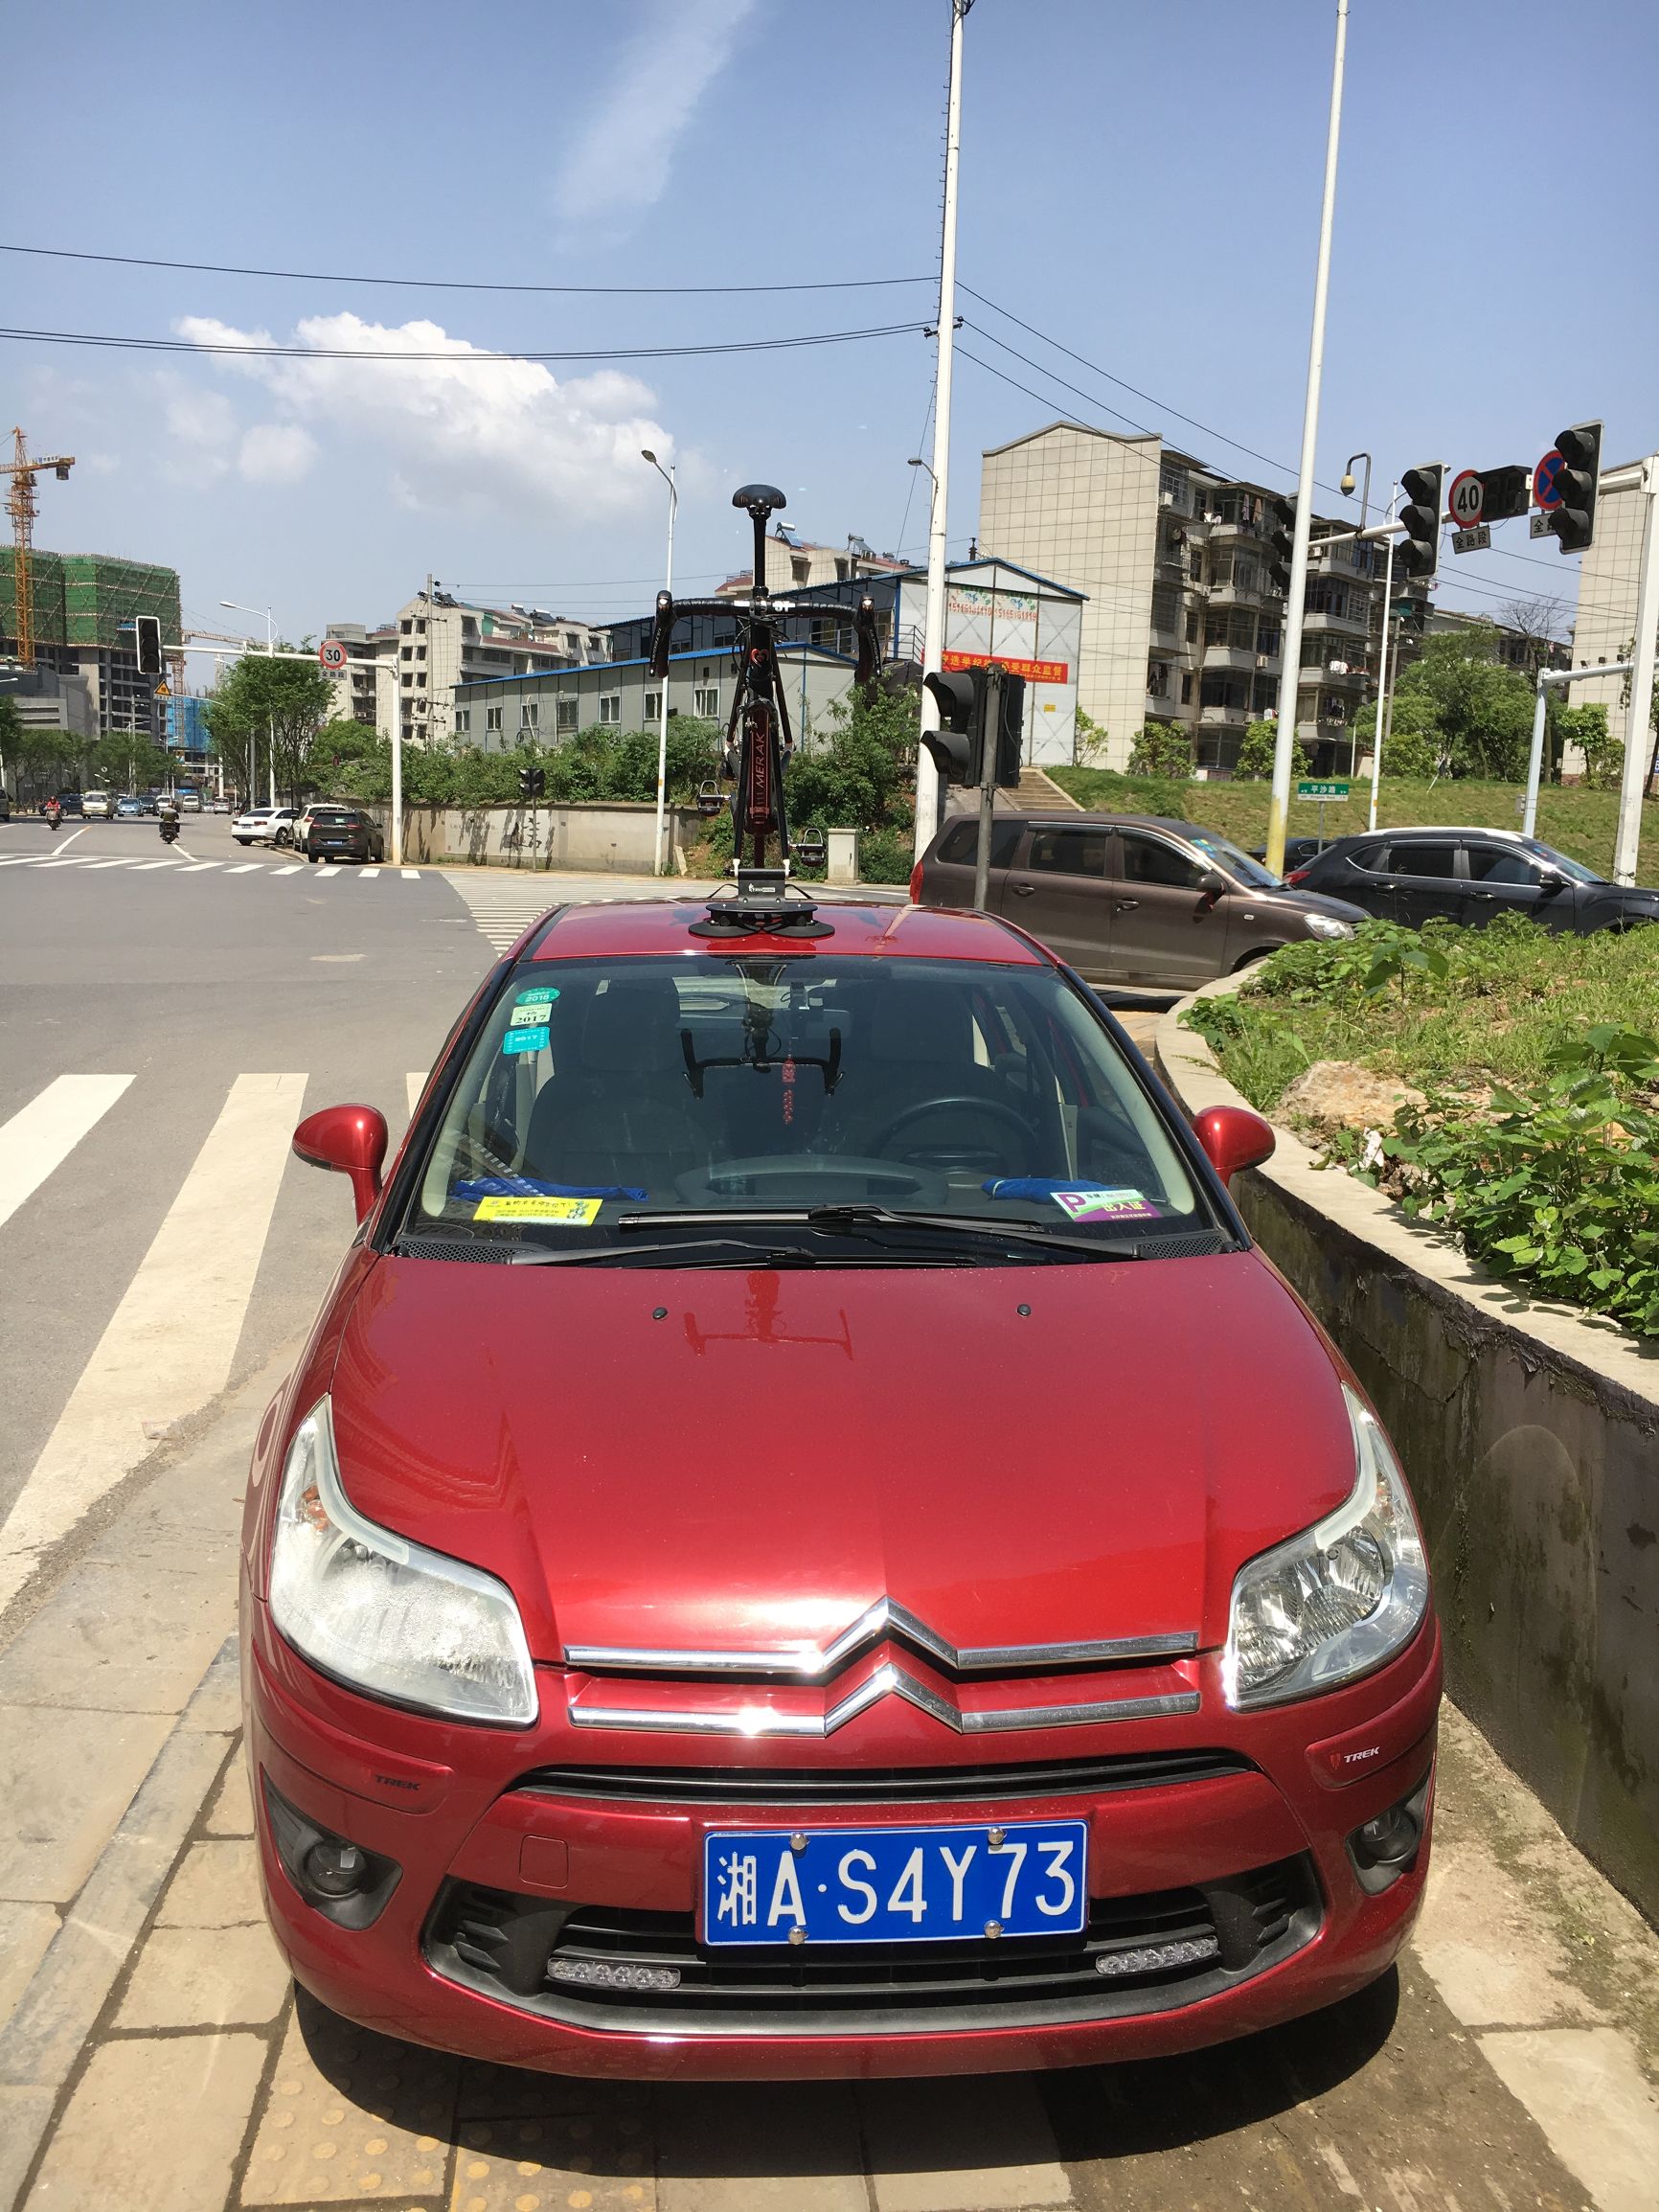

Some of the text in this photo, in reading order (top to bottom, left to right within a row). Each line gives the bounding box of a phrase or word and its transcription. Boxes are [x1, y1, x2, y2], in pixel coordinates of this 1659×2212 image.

[1457, 485, 1480, 513] 40
[1455, 532, 1488, 550] 全路段
[326, 650, 341, 661] 30
[321, 670, 345, 678] 全路段
[755, 732, 765, 788] MERAK
[515, 1015, 546, 1024] 2017
[1057, 1194, 1087, 1213] P
[1102, 1201, 1147, 1212] 出入证
[1343, 1746, 1380, 1764] TREK
[375, 1774, 422, 1791] TREK
[716, 1840, 1077, 1927] 湘A·S4Y73
